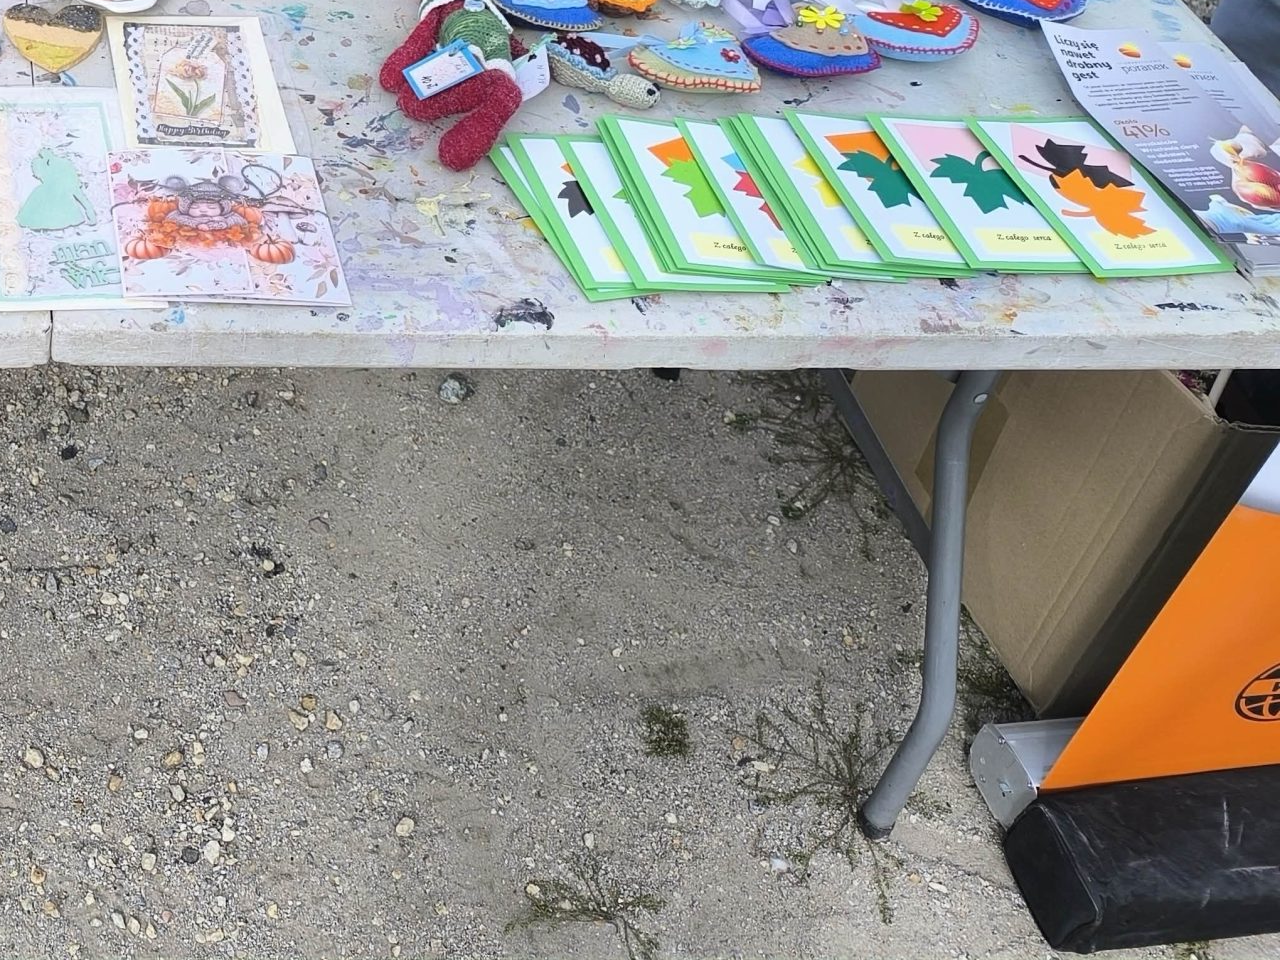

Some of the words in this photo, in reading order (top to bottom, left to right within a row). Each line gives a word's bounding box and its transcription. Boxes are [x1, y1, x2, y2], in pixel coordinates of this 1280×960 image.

[1053, 34, 1080, 50] Liczy
[1080, 40, 1099, 51] się
[1060, 48, 1096, 59] nawet
[1066, 59, 1113, 70] drobny
[1120, 62, 1169, 74] poranek
[1071, 70, 1100, 82] gest
[158, 124, 185, 136] Happy
[187, 126, 228, 137] Birthday
[1122, 123, 1171, 139] 41%
[1005, 233, 1029, 243] całego
[722, 242, 747, 252] całego
[1122, 242, 1146, 251] całego
